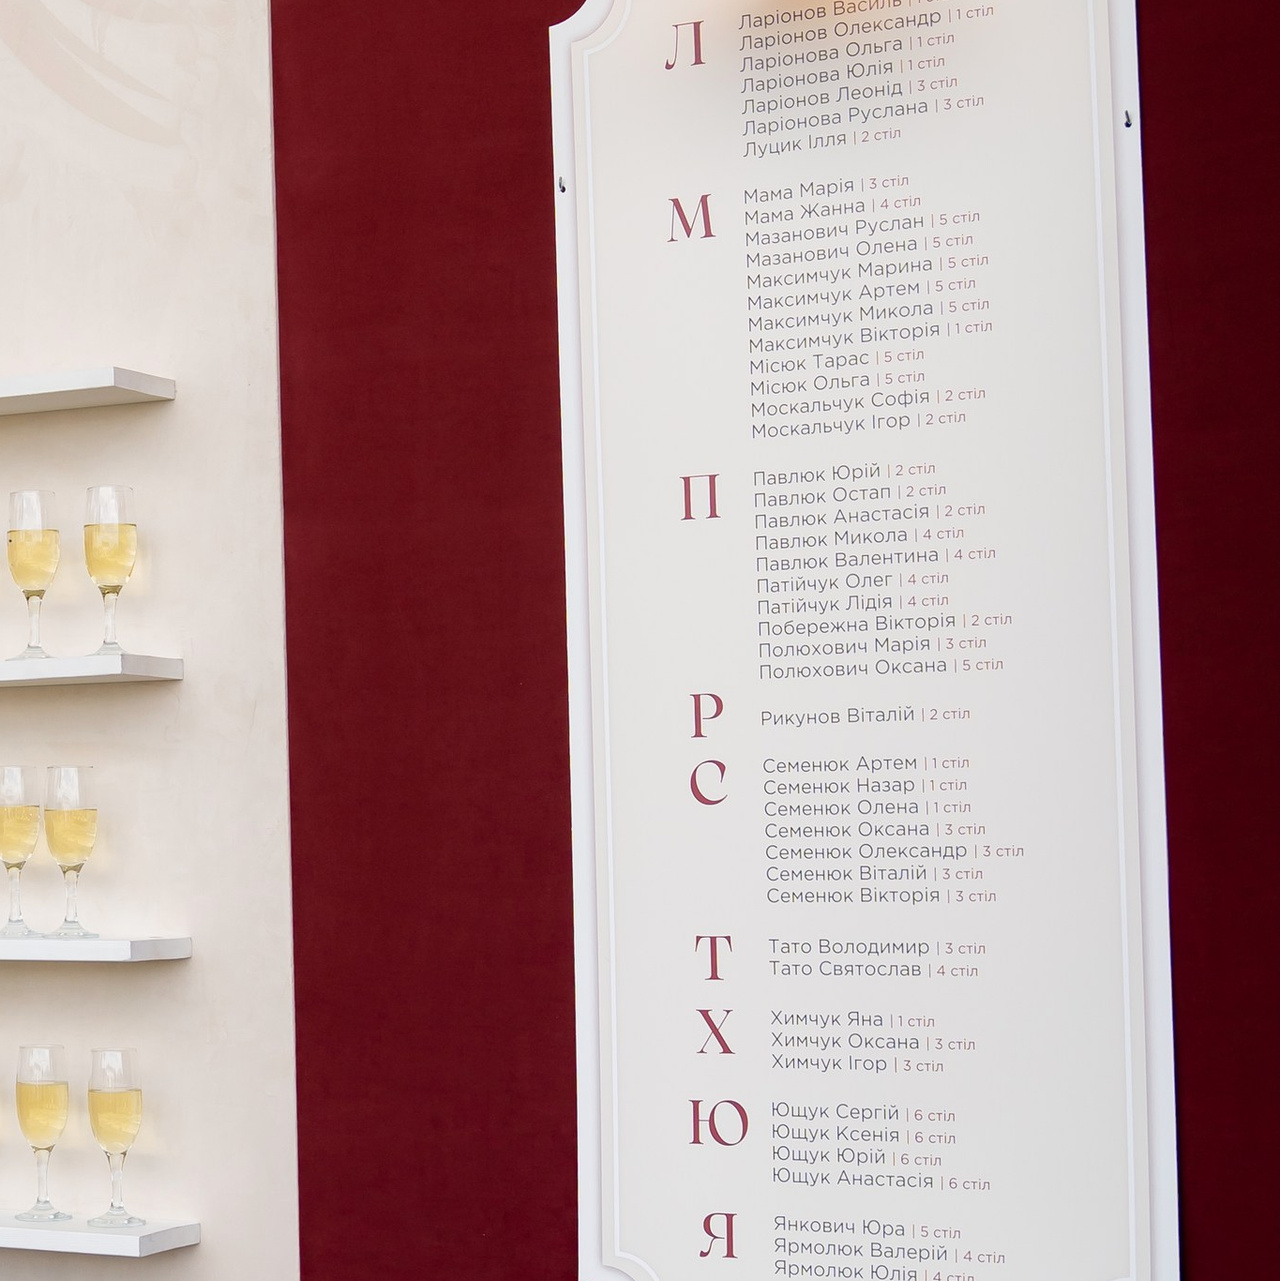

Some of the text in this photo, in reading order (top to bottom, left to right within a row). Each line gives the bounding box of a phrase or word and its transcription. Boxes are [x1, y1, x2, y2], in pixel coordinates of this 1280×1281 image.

[738, 6, 827, 30] Ларіонов
[739, 28, 828, 52] Ларіонов
[834, 11, 942, 37] Олександр
[966, 5, 994, 19] стіл
[665, 20, 706, 70] Л
[741, 76, 958, 115] Ларіонов Леонід 3 стіл
[742, 127, 901, 159] Луцик Ілля 2 стіл
[744, 174, 909, 205] Мама Марія 3 стіл
[667, 193, 716, 243] М
[745, 195, 921, 226] Мама Жанна 4 стіл
[745, 210, 980, 247] Мазанович Руслан 5 стіл
[747, 254, 989, 290] Максимчук Марина 5 стіл
[750, 348, 924, 375] Місюк Тарас 5 стіл
[751, 387, 986, 418] Москальчук Софія 2 стіл
[679, 473, 721, 521] П
[754, 483, 946, 508] Павлюк Остап 2 стіл
[755, 503, 986, 530] Павлюк Анастасія 2 стіл
[757, 571, 949, 594] Патійчук Олег 4 стіл
[758, 612, 1012, 637] Побережна Вікторія 2 стіл
[759, 658, 1004, 680] Полюхович Оксана 5 стіл
[690, 692, 724, 738] Р
[761, 705, 971, 728] Рикунов Віталій 2 стіл
[762, 758, 850, 774] Семенюк
[855, 755, 917, 774] Артем
[941, 756, 970, 769] стіл
[690, 759, 728, 806] С
[766, 886, 997, 906] Семенюк Вікторія 3 стіл
[694, 935, 733, 981] Т
[769, 960, 978, 977] Тато Святослав 4 стіл
[696, 1009, 736, 1055] Х
[771, 1053, 944, 1074] Химчук Ігор 3 стіл
[688, 1099, 749, 1146] Ю
[772, 1123, 956, 1144] Ющук Ксенія 6 стіл
[699, 1212, 738, 1259] Я
[774, 1215, 961, 1239] Янкович Юра 5 стіл
